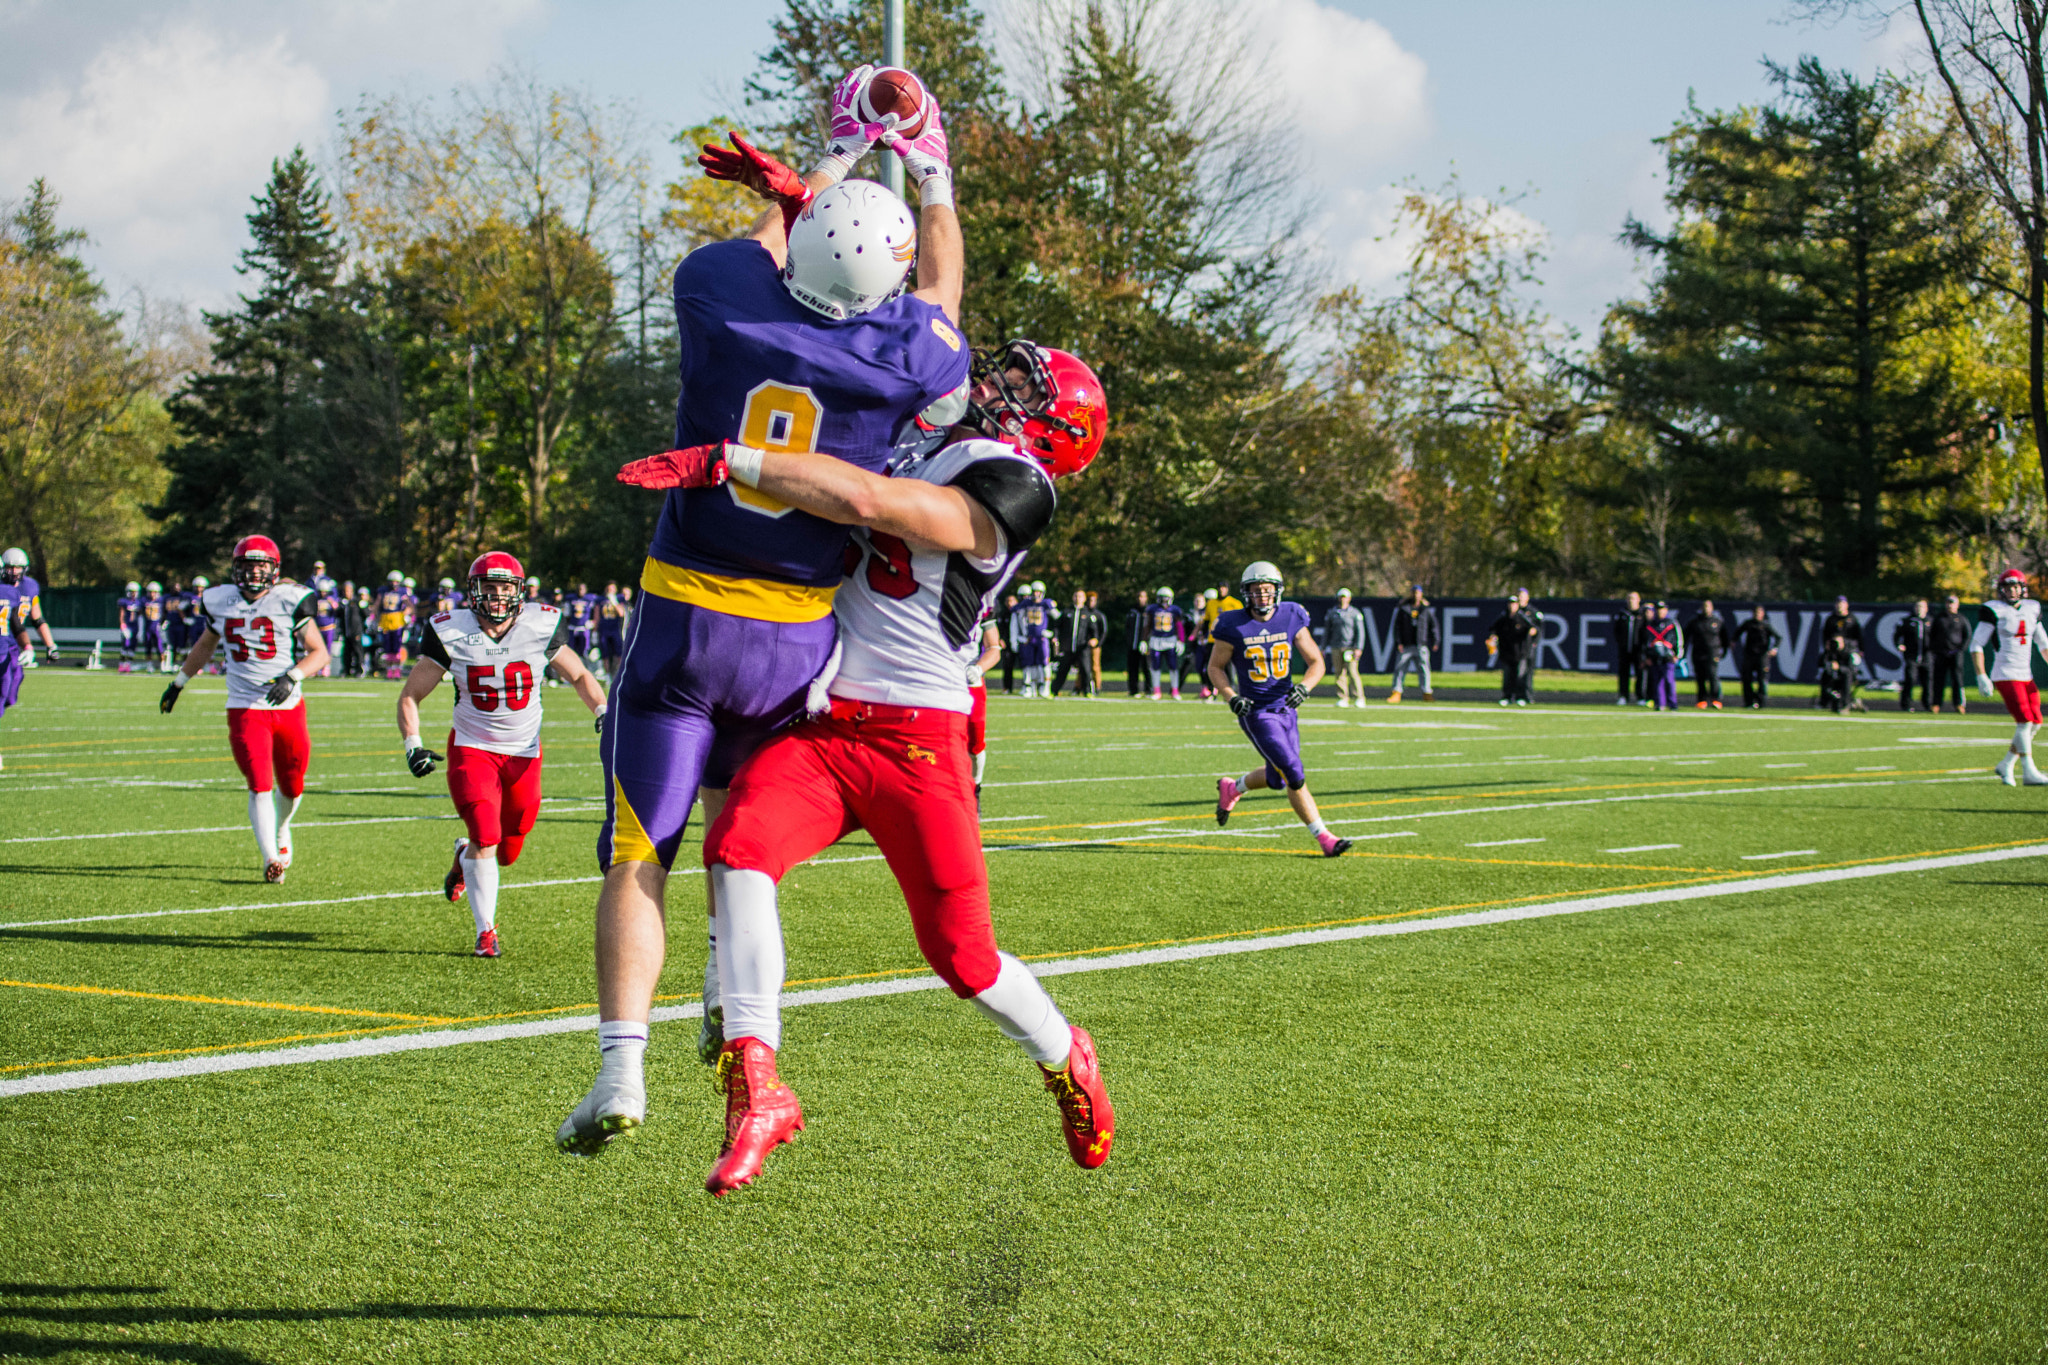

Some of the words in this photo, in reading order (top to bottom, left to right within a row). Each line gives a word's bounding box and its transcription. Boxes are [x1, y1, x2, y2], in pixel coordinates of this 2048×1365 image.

[930, 317, 961, 352] 8
[223, 616, 279, 663] 53
[2013, 620, 2028, 645] 4
[1244, 641, 1291, 682] 30
[466, 660, 534, 712] 50
